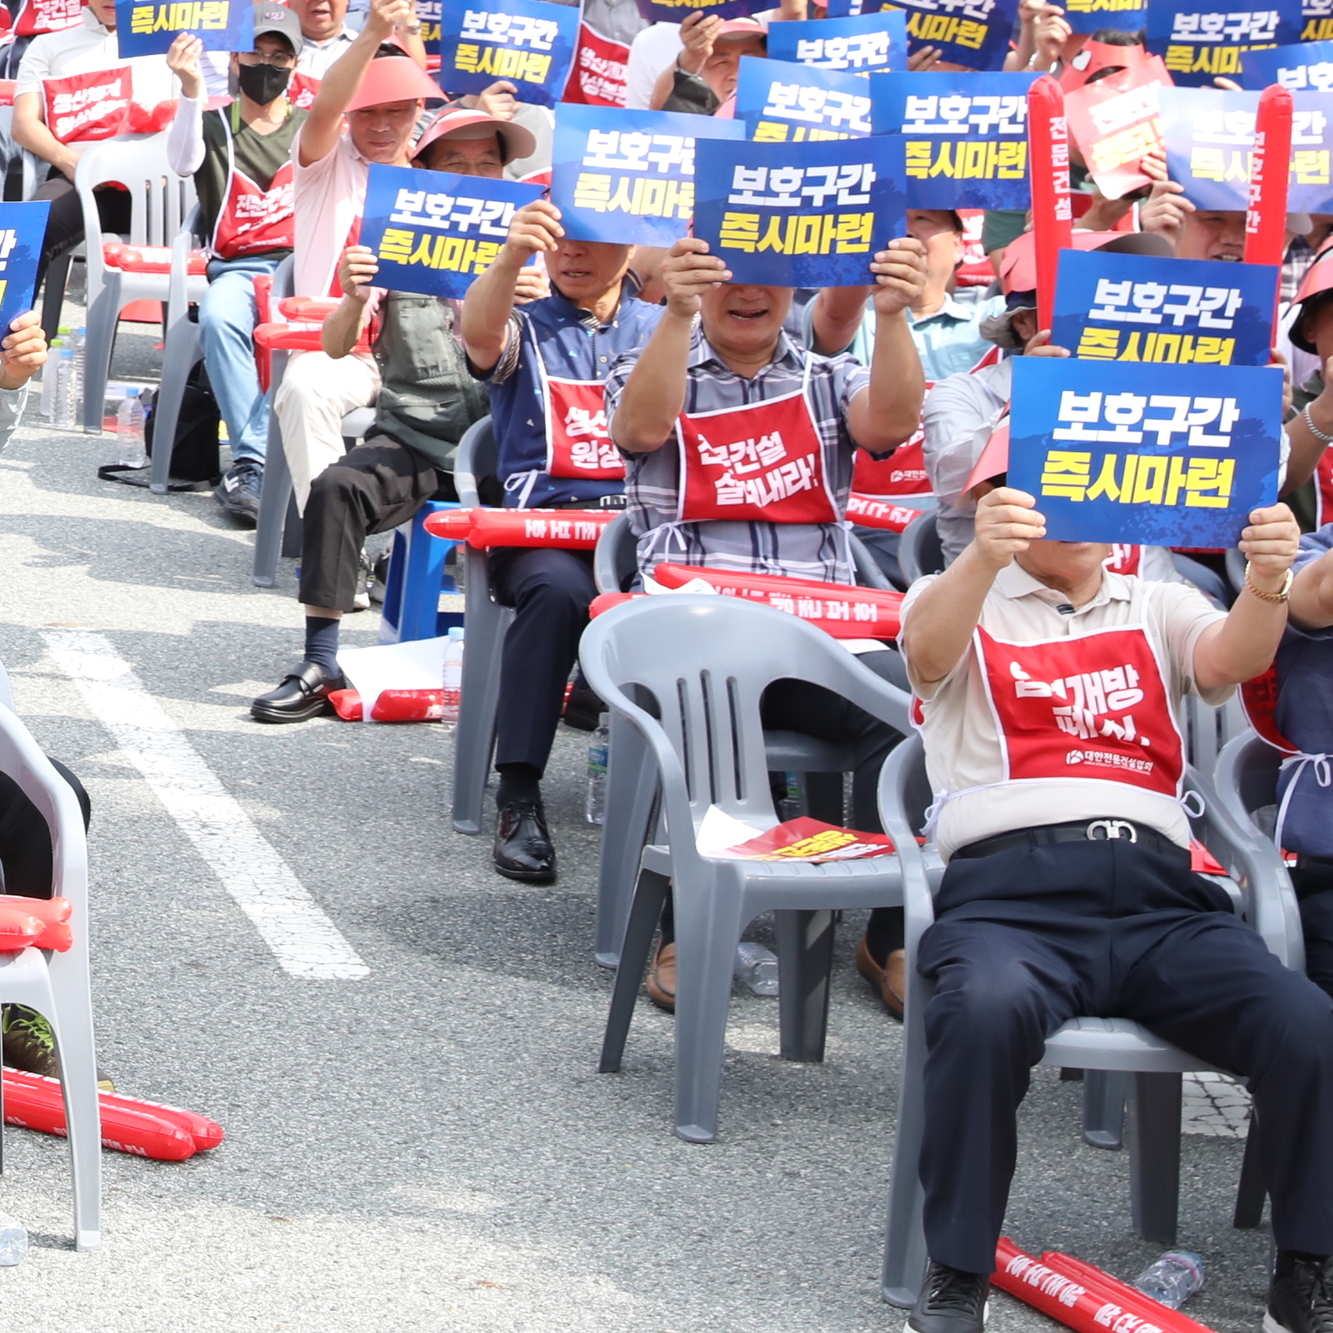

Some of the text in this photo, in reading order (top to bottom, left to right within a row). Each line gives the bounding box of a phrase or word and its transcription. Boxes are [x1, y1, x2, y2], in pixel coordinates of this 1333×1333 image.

[133, 2, 227, 33] 즉시마련
[462, 11, 558, 52] 보호구간
[456, 44, 550, 82] 즉시마련
[903, 95, 1027, 133] 보호구간
[907, 142, 1027, 178] 즉시마련
[1048, 117, 1072, 221] 전문건설
[729, 164, 875, 206] 보호구간
[1245, 130, 1266, 233] 보호구간
[721, 213, 873, 254] 즉시마련
[1054, 392, 1239, 447] 보호구간
[1043, 452, 1234, 507] 즉시마련
[1083, 751, 1154, 774] 대한전문건설협회
